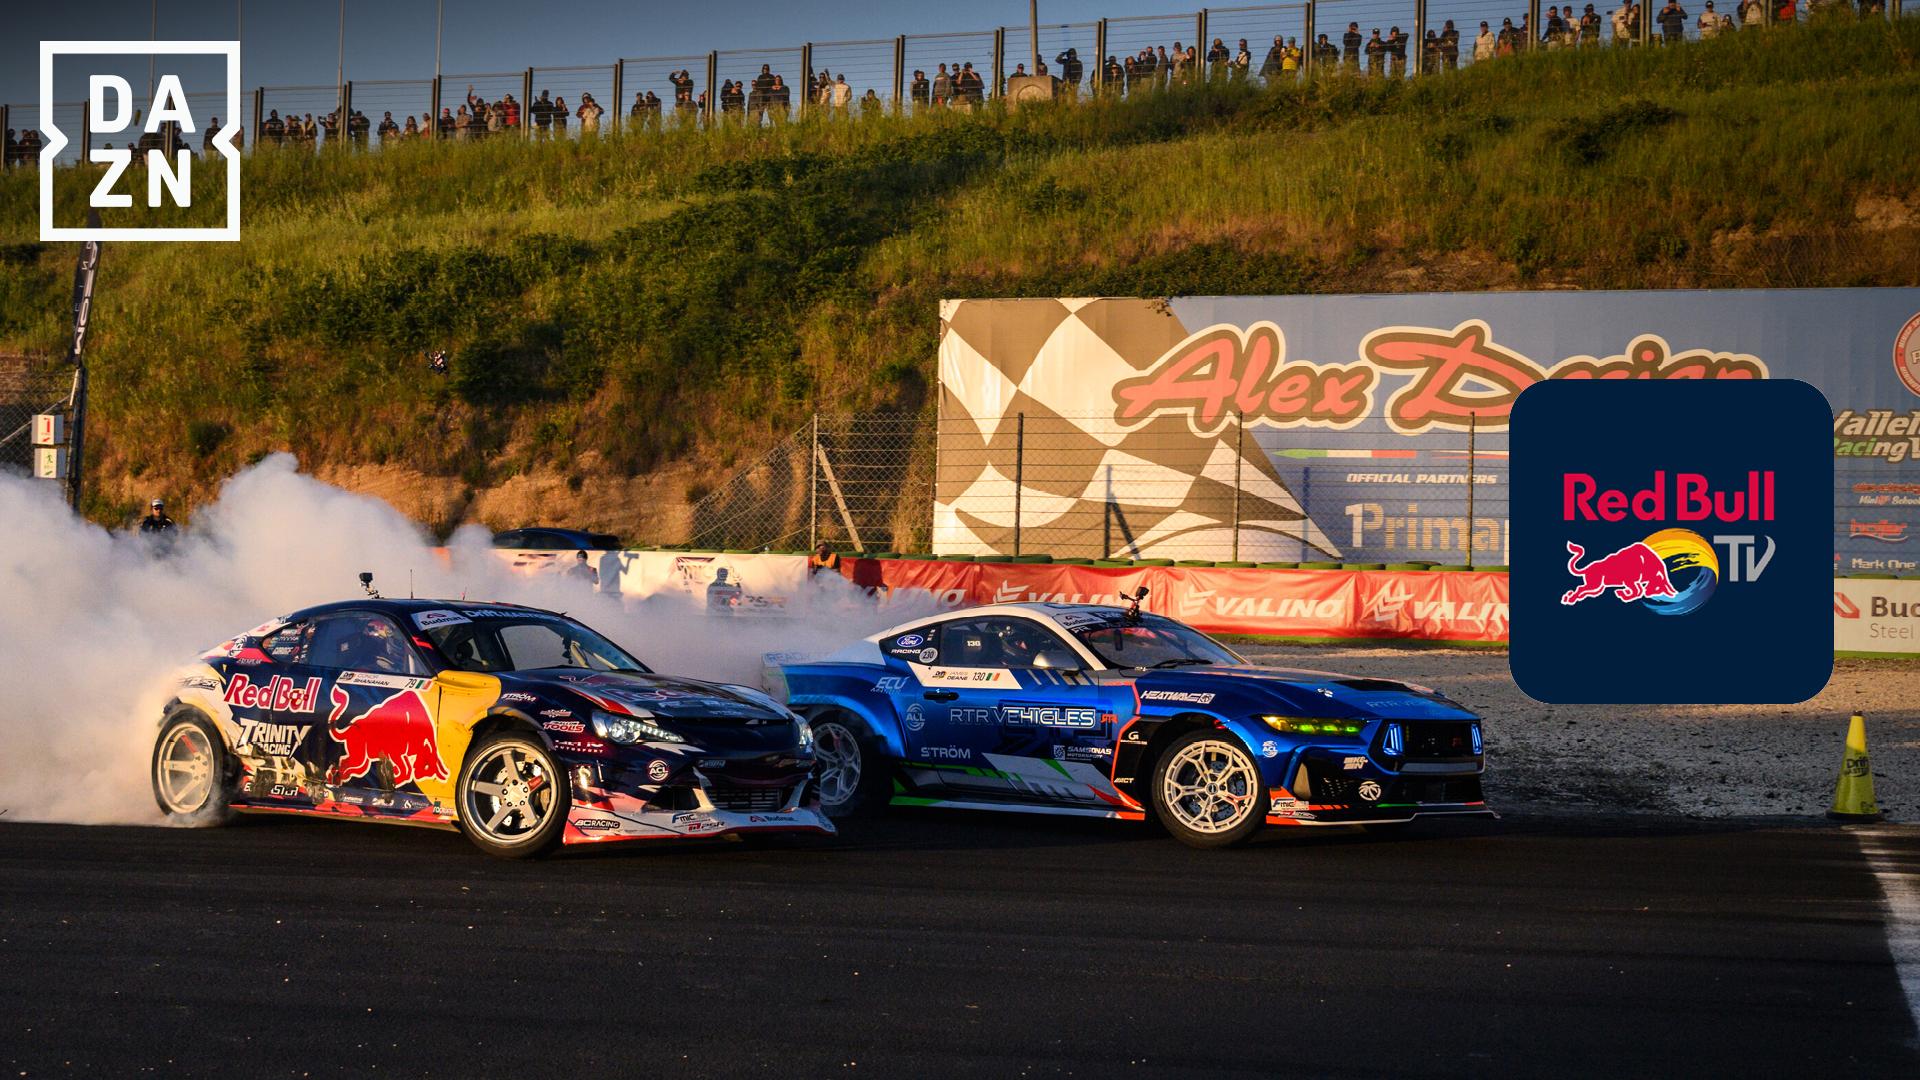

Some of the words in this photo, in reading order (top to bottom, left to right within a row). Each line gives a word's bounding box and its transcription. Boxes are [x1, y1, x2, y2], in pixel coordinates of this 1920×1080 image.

[1111, 322, 1375, 434] Alex
[1346, 473, 1411, 483] OFFICIAL
[1852, 558, 1884, 569] Mark
[1888, 559, 1916, 569] One
[1215, 597, 1344, 618] VALINO
[1870, 622, 1914, 639] Steel
[900, 635, 920, 646] Ford
[404, 678, 417, 688] 79
[972, 672, 986, 681] 130
[224, 673, 280, 709] Red
[950, 708, 989, 722] RTR
[991, 707, 1095, 727] VEHICLES
[236, 717, 312, 750] TRINITY
[921, 745, 971, 759] STRÖM
[649, 766, 669, 775] ACL
